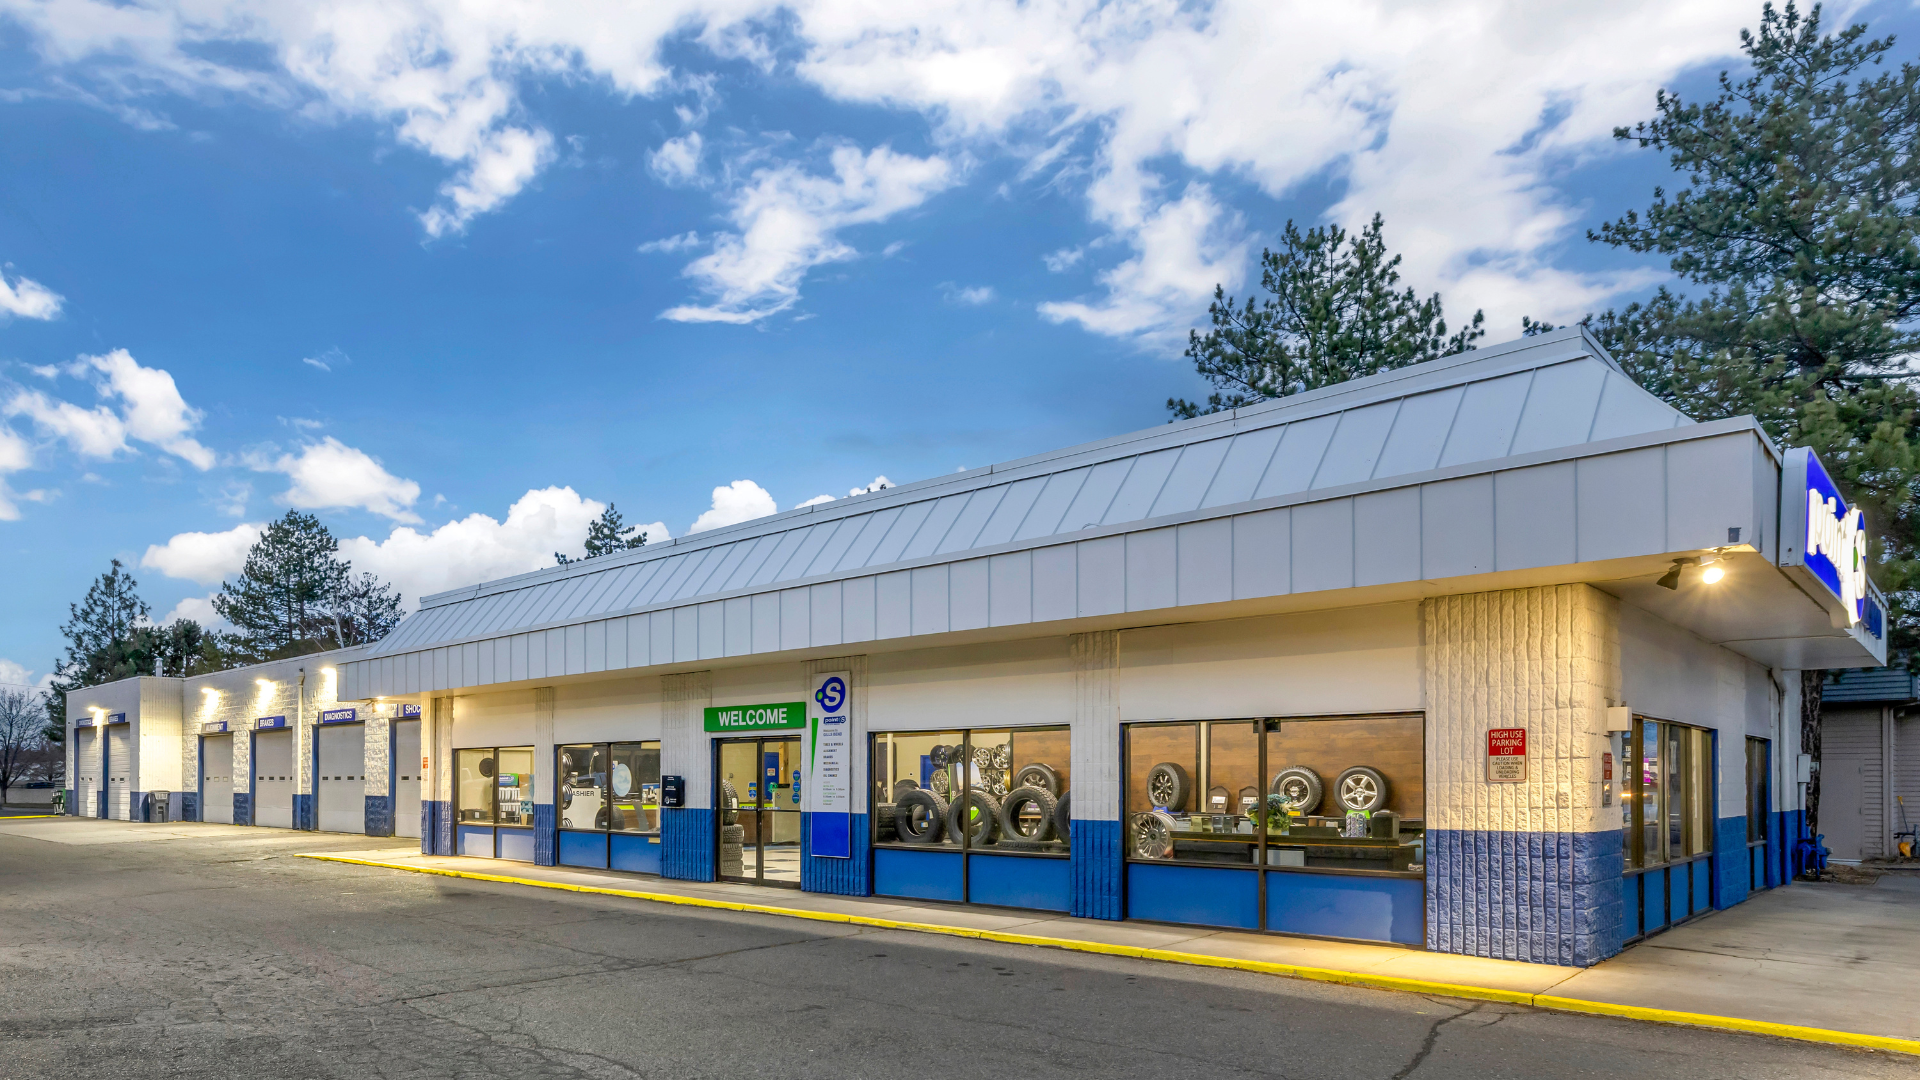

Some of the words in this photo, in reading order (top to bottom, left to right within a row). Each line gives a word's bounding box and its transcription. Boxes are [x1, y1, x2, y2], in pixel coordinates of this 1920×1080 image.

[824, 682, 841, 707] S
[405, 705, 421, 714] SHOC
[324, 710, 352, 721] DIAGNOSTICS
[718, 708, 788, 727] WELCOME
[259, 718, 275, 728] BRAKES
[1490, 730, 1509, 739] HIGH
[1510, 730, 1523, 739] USE
[1491, 738, 1523, 747] PARKING
[1500, 746, 1514, 755] LOT
